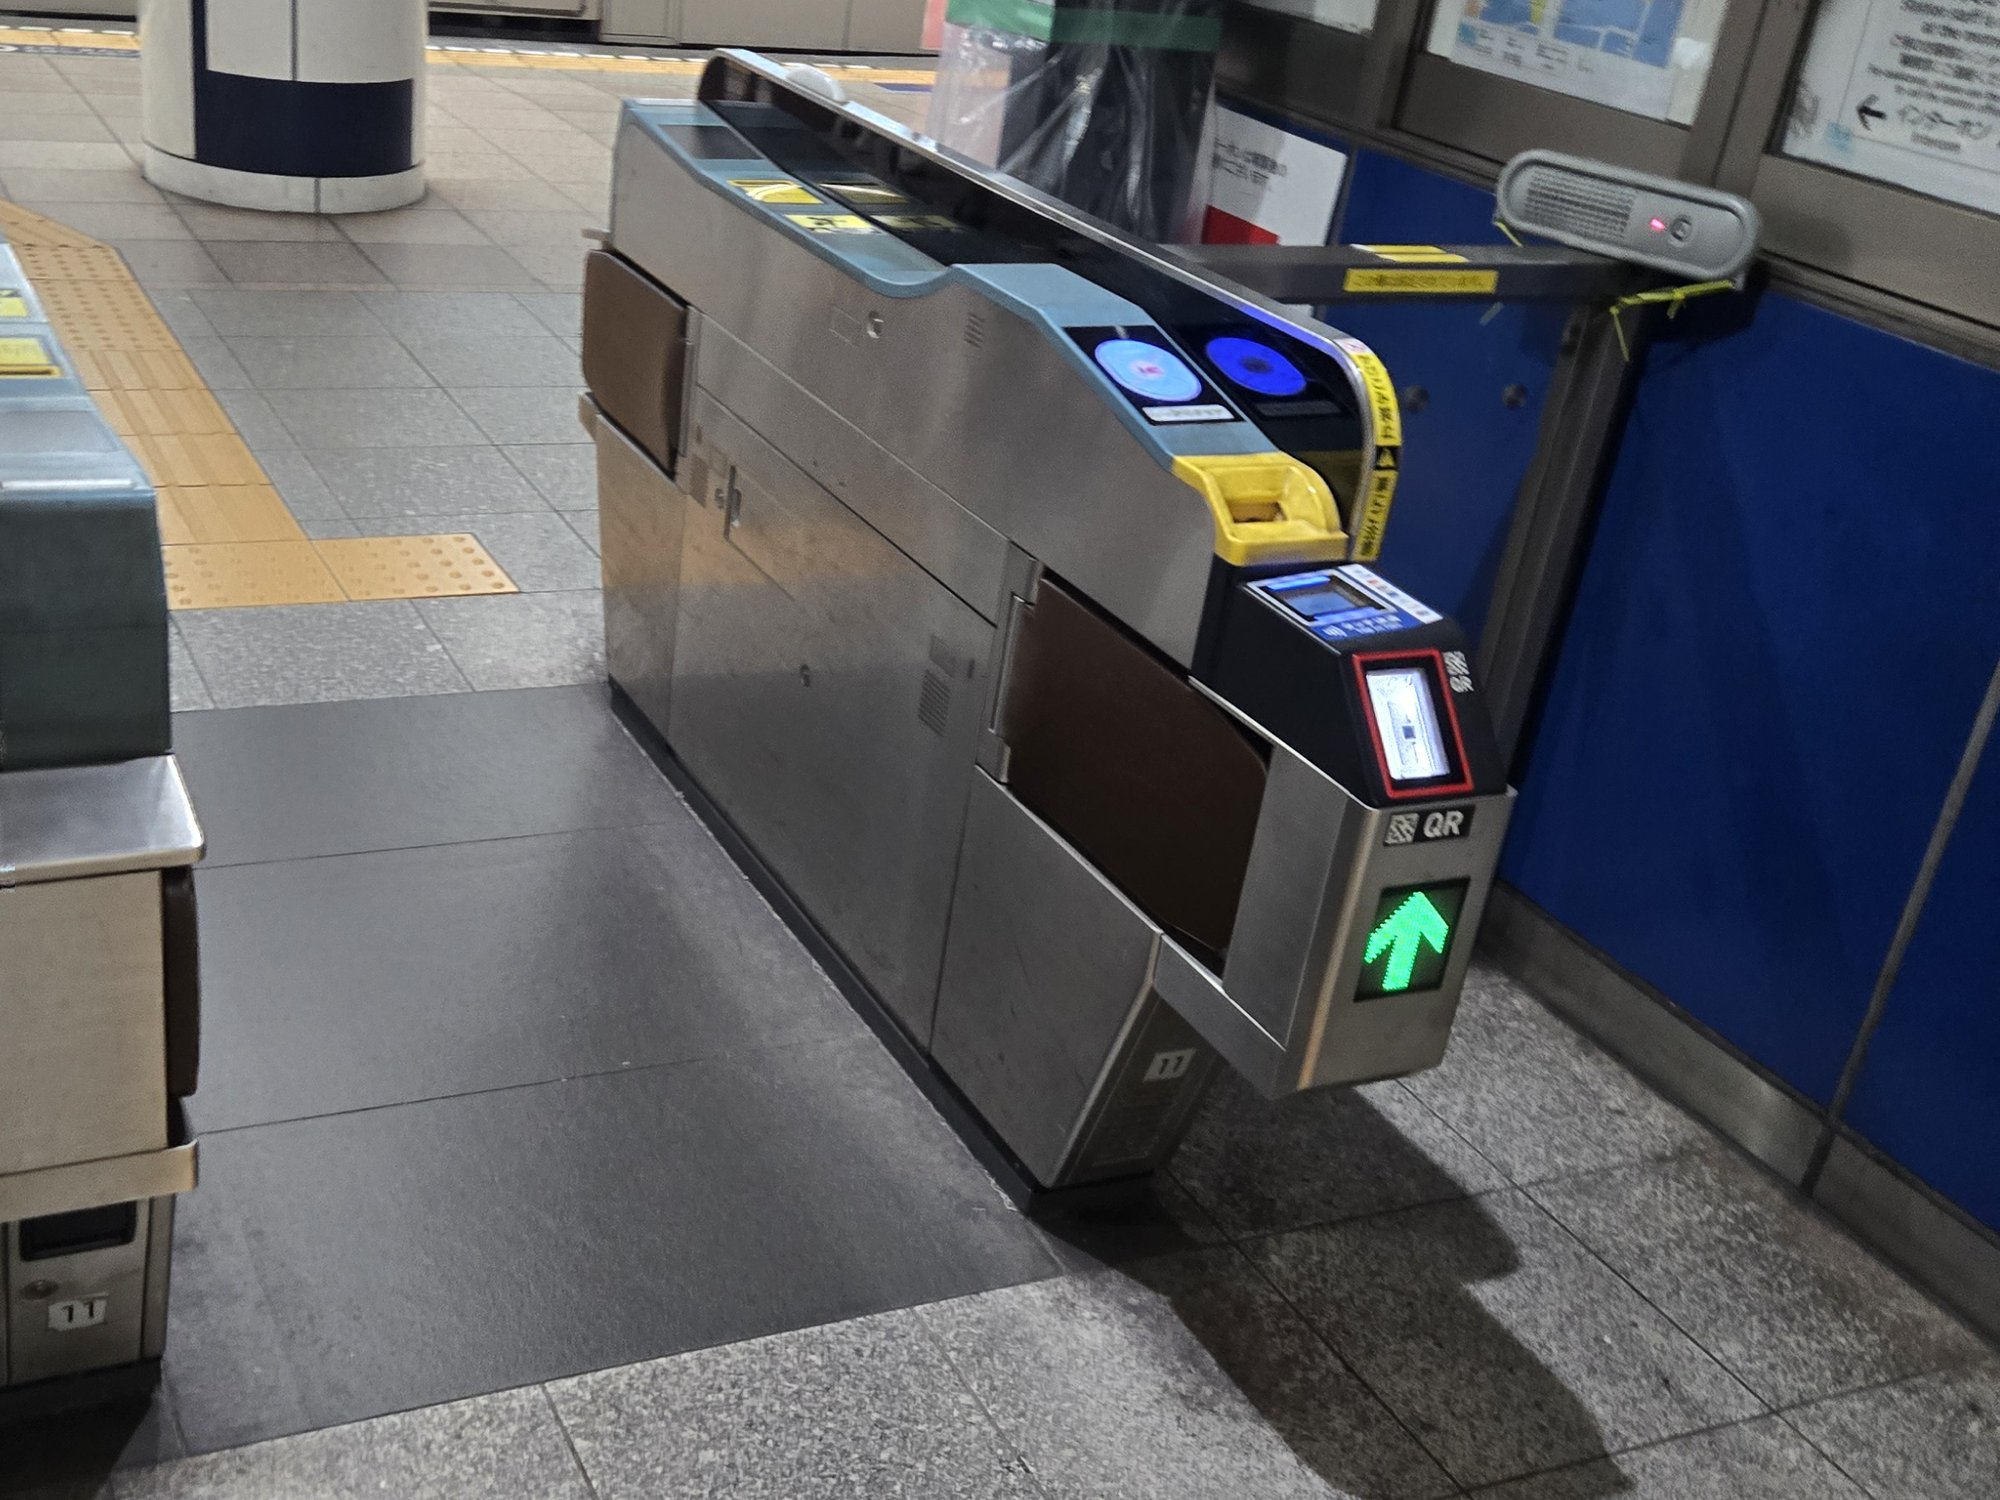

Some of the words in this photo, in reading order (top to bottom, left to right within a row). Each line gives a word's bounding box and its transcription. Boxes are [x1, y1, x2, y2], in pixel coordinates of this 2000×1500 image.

[1423, 810, 1464, 838] QR
[1159, 1056, 1184, 1075] 11
[61, 1301, 94, 1323] 11
